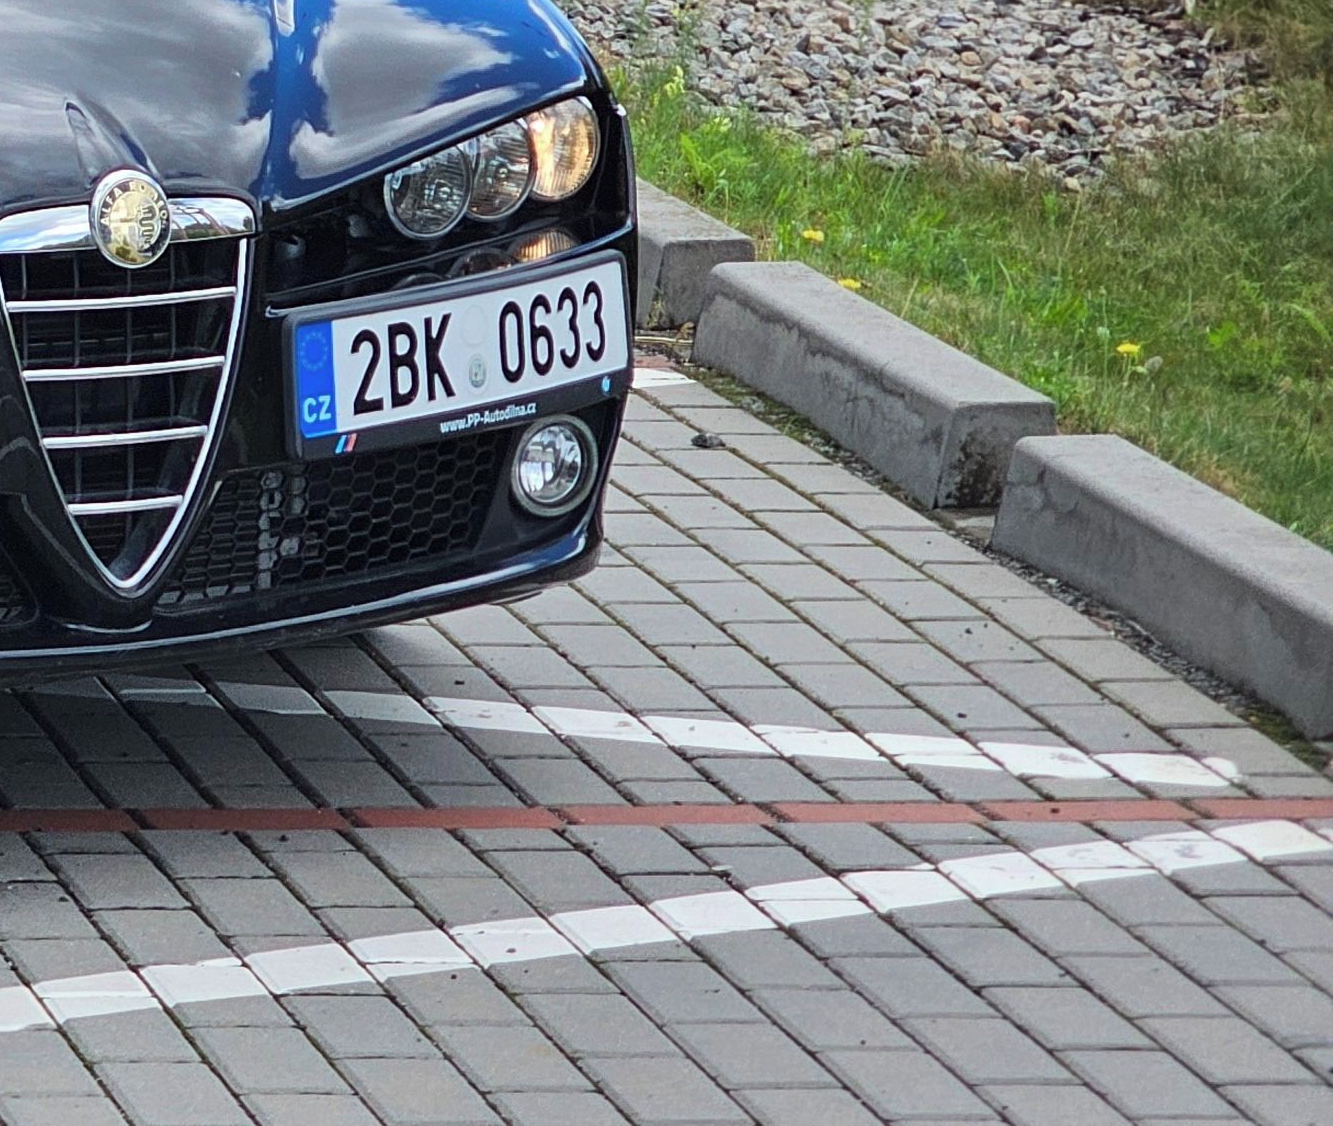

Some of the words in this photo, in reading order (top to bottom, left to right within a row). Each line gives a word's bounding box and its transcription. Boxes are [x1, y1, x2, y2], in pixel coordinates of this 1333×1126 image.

[100, 187, 124, 226] ALFA
[350, 312, 456, 416] 2BK
[498, 280, 606, 384] 0633
[302, 394, 332, 424] CZ
